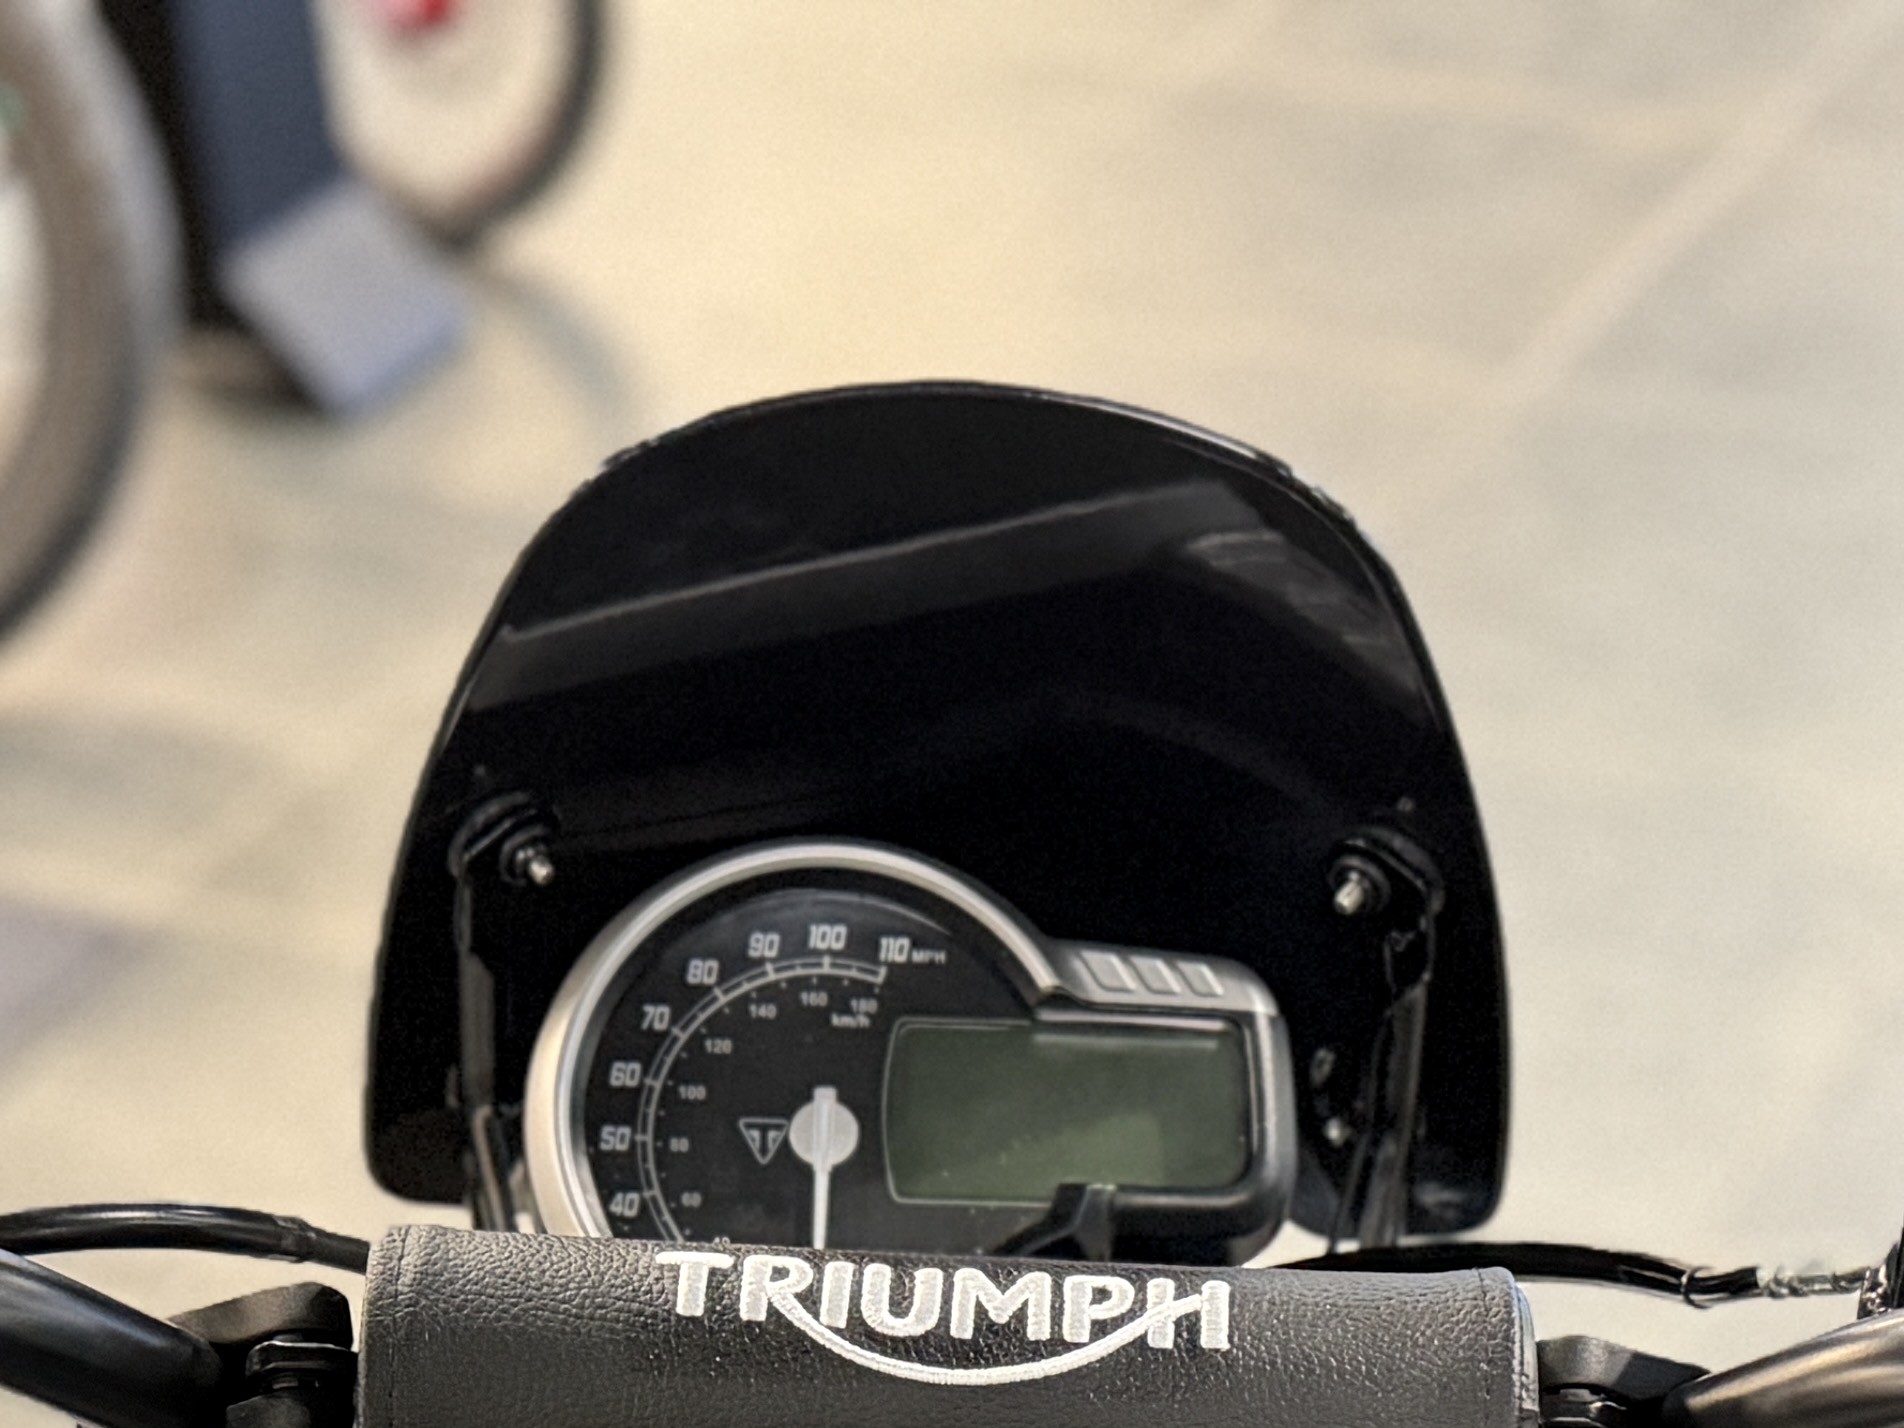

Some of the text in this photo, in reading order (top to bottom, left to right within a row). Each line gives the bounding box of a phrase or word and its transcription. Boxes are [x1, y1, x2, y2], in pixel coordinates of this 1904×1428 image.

[748, 931, 780, 958] 90
[809, 924, 847, 950] 100
[879, 936, 946, 964] 110 MPH
[686, 959, 719, 985] 80
[641, 1004, 671, 1030] 70
[749, 1004, 777, 1019] 140
[704, 1039, 733, 1054] 120
[609, 1061, 642, 1087] 60
[678, 1085, 706, 1100] 100
[600, 1125, 631, 1151] 50
[609, 1192, 640, 1217] 40
[654, 1250, 1232, 1385] TRIUMPH
